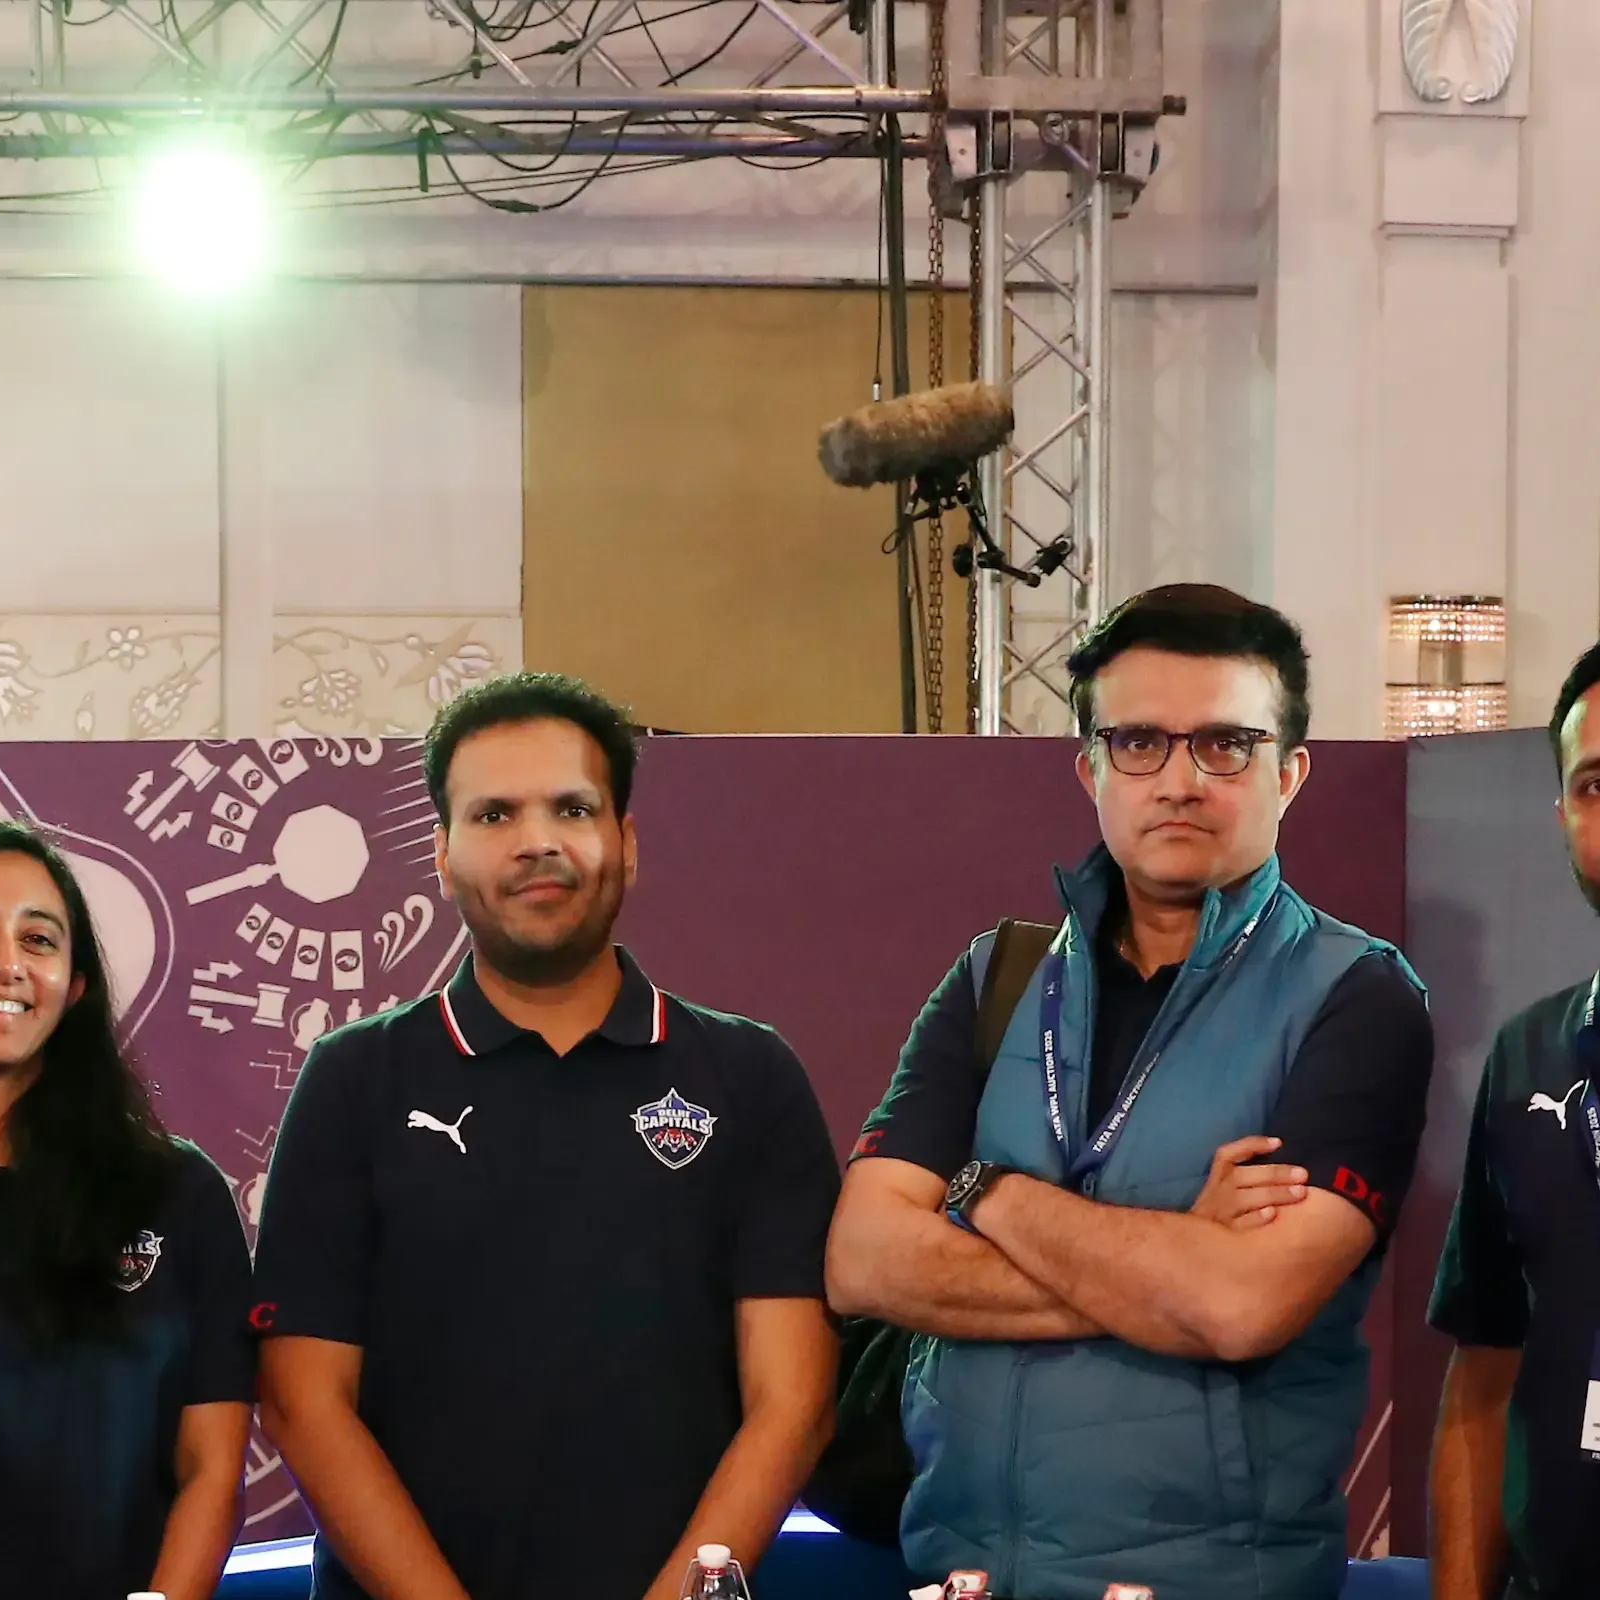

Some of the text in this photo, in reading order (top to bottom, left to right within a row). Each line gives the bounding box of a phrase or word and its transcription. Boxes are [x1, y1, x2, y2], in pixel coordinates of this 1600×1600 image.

[1044, 1030, 1063, 1141] TATA WPL AUCTION 2025
[657, 1108, 691, 1118] DELHI
[1092, 1073, 1146, 1152] TATA WPL AUCTION
[1586, 1106, 1599, 1129] 2025
[639, 1115, 709, 1135] CAPITALS
